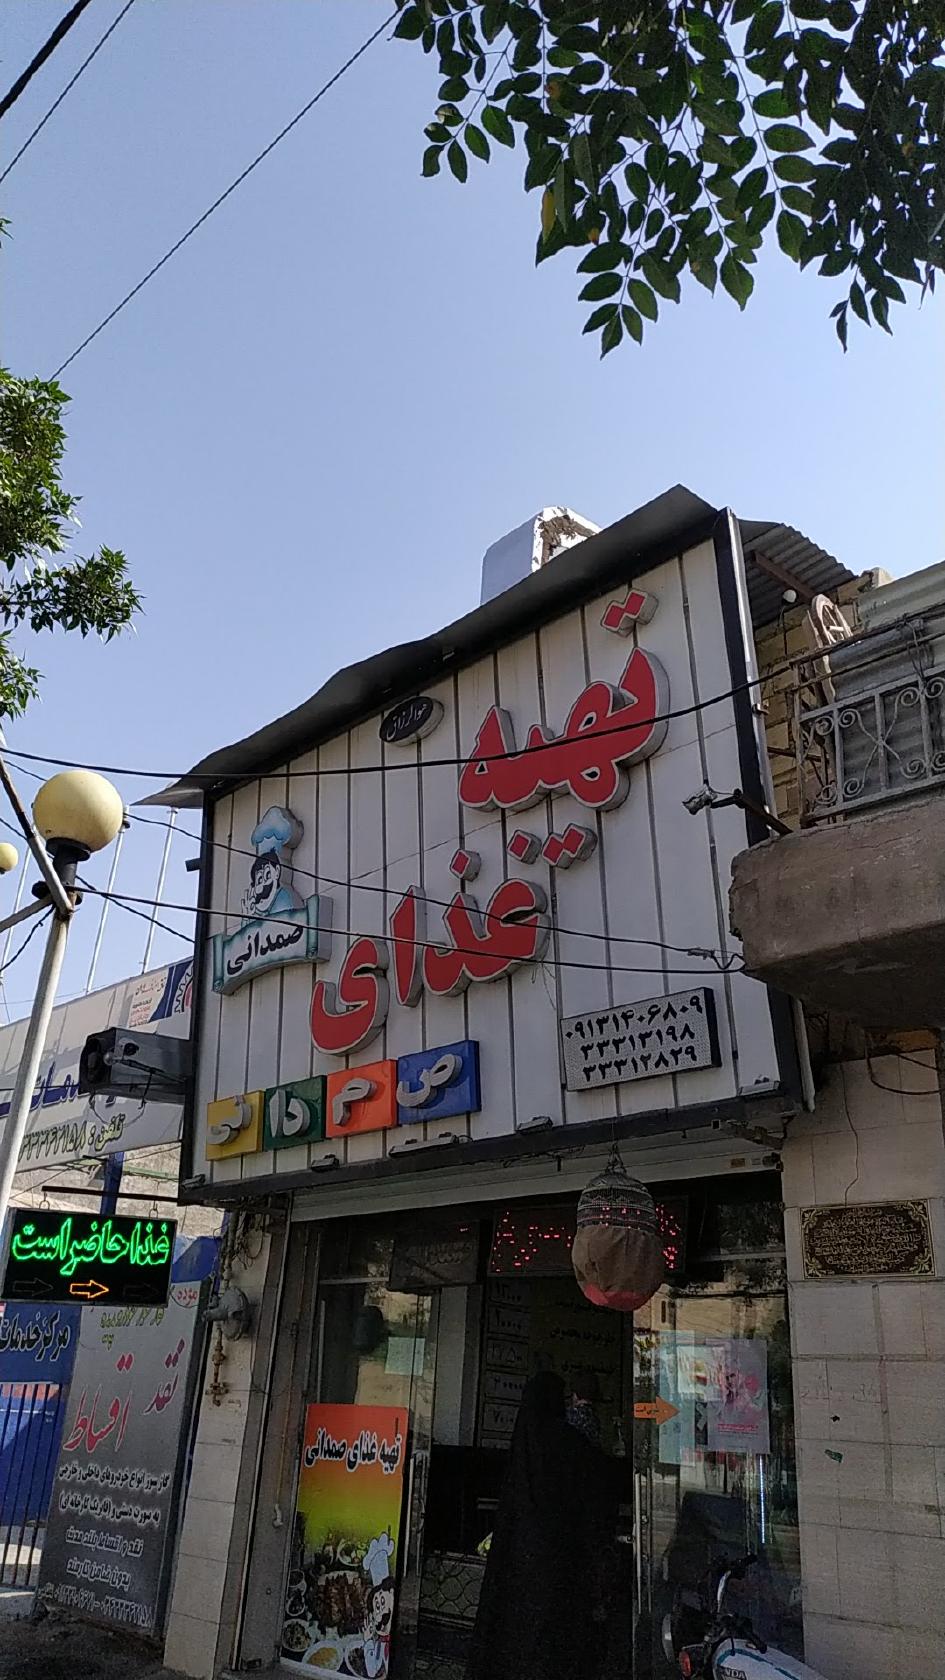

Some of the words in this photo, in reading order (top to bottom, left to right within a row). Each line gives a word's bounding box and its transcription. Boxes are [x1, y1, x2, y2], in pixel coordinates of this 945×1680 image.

[458, 588, 662, 868] تهیه
[226, 925, 304, 976] صمدانی
[309, 829, 548, 1058] غذای
[565, 995, 703, 1039] ۰۹۱۳۱۴۰۶۸۰۹
[580, 1023, 695, 1061] ۳۳۳۱۳۱۹۸
[582, 1045, 698, 1082] ۳۳۳۱۲۸۲۹
[12, 1217, 72, 1261] است
[59, 1219, 130, 1276] حاضر
[130, 1221, 170, 1266] غذا
[0, 1311, 43, 1353] خدمات
[35, 1310, 71, 1362] مرکز
[62, 1353, 136, 1453] اقساط
[304, 1427, 347, 1467] صمدانی
[346, 1430, 378, 1472] غذای
[380, 1434, 402, 1474] تهیه
